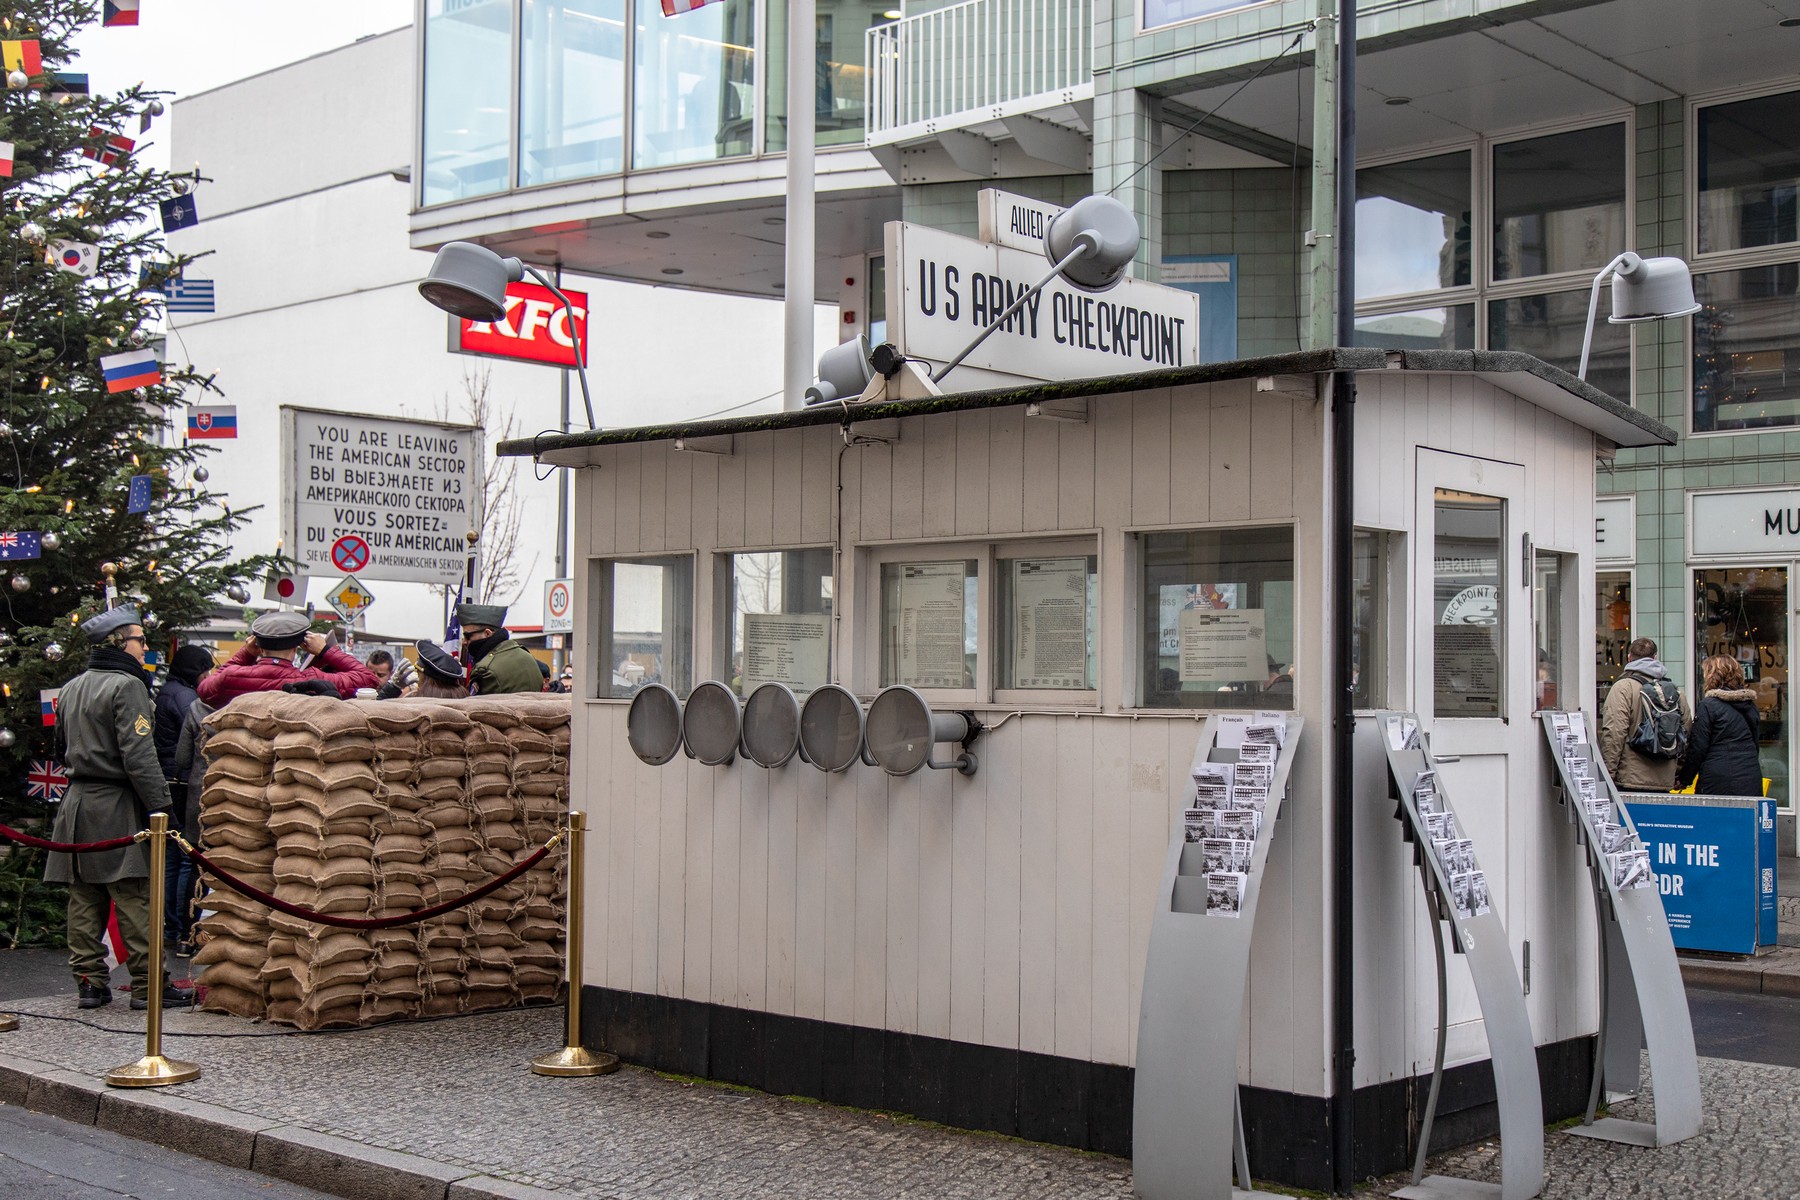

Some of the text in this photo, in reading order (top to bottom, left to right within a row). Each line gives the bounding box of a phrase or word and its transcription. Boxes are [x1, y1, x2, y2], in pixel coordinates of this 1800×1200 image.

[1011, 205, 1043, 240] ALLIED
[467, 295, 586, 348] KFC
[971, 272, 1042, 339] ARMY
[1053, 291, 1185, 367] CHECKPOINT
[317, 425, 458, 454] YOU ARE LEAVING
[309, 444, 466, 474] THE AMERICAN SECTOR
[310, 466, 461, 494] ВЫ ВЫЕЗЖАЕТЕ ИЗ
[306, 485, 466, 513] АМЕРИКАНСКОГО СЕКТОРА
[334, 508, 440, 532] VOUS SORTEZ
[307, 526, 464, 553] DU SEUR AMÉRICAIN
[306, 549, 319, 561] SIE
[378, 556, 438, 570] AMERIKANISCHEN
[439, 557, 465, 571] SEKTOR
[553, 592, 566, 608] 30
[1443, 588, 1490, 625] HECKPOINT
[1658, 842, 1720, 867] IN THE
